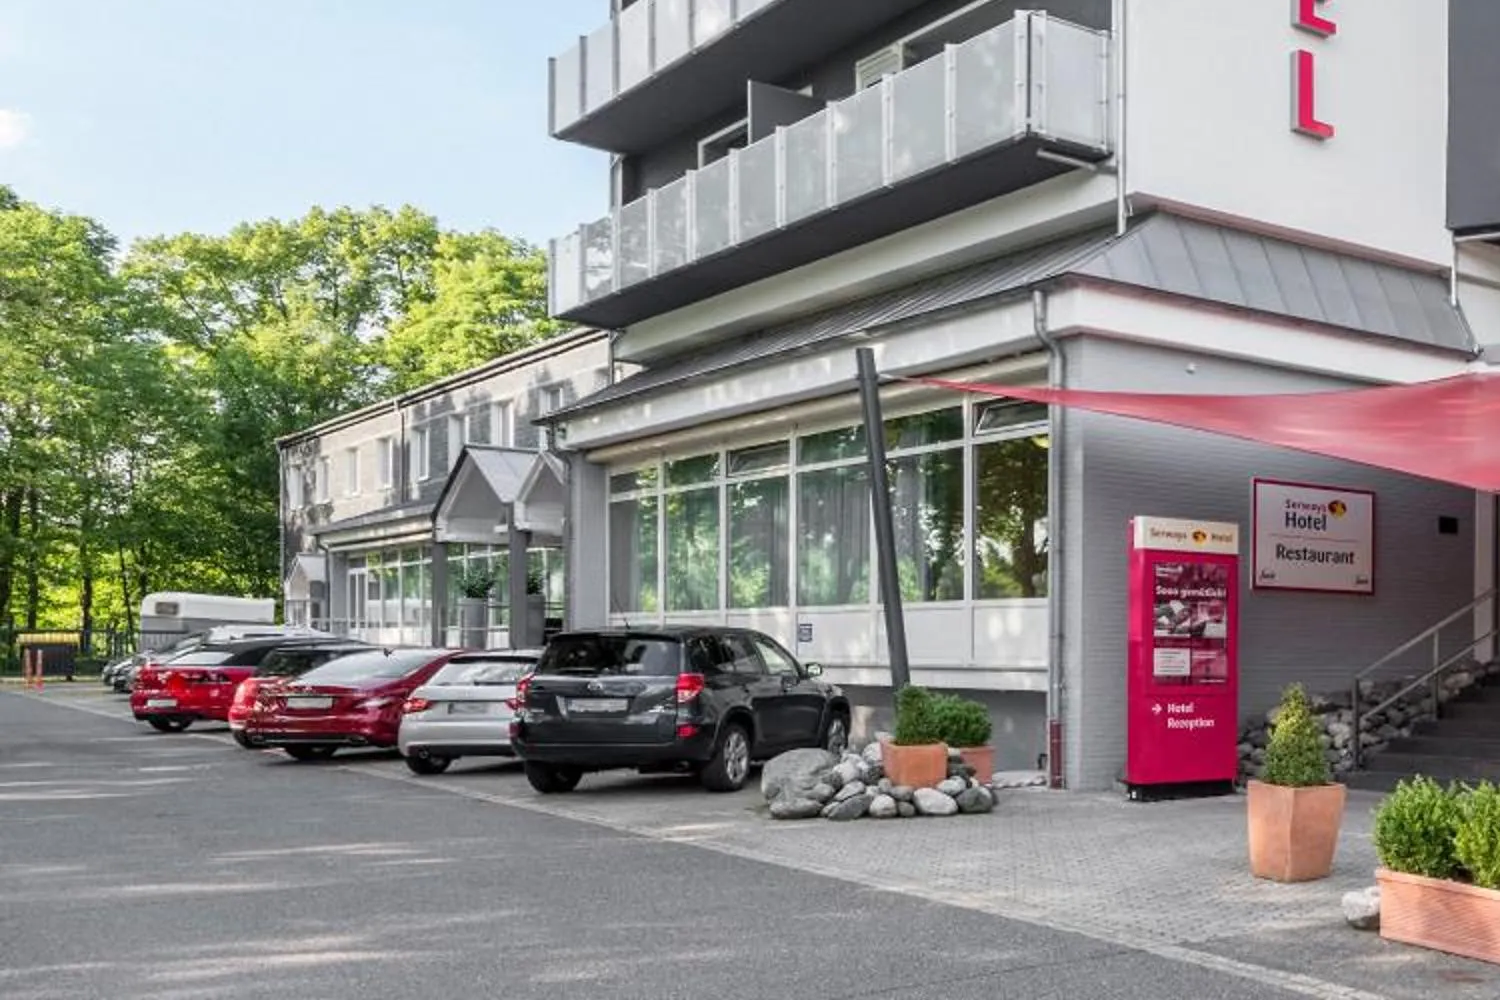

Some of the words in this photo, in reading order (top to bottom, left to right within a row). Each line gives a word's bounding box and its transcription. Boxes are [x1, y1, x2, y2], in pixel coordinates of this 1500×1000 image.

[1285, 499, 1327, 514] Serways
[1285, 511, 1327, 531] Hotel
[1275, 543, 1355, 565] Restaurant
[1167, 701, 1195, 714] Hotel
